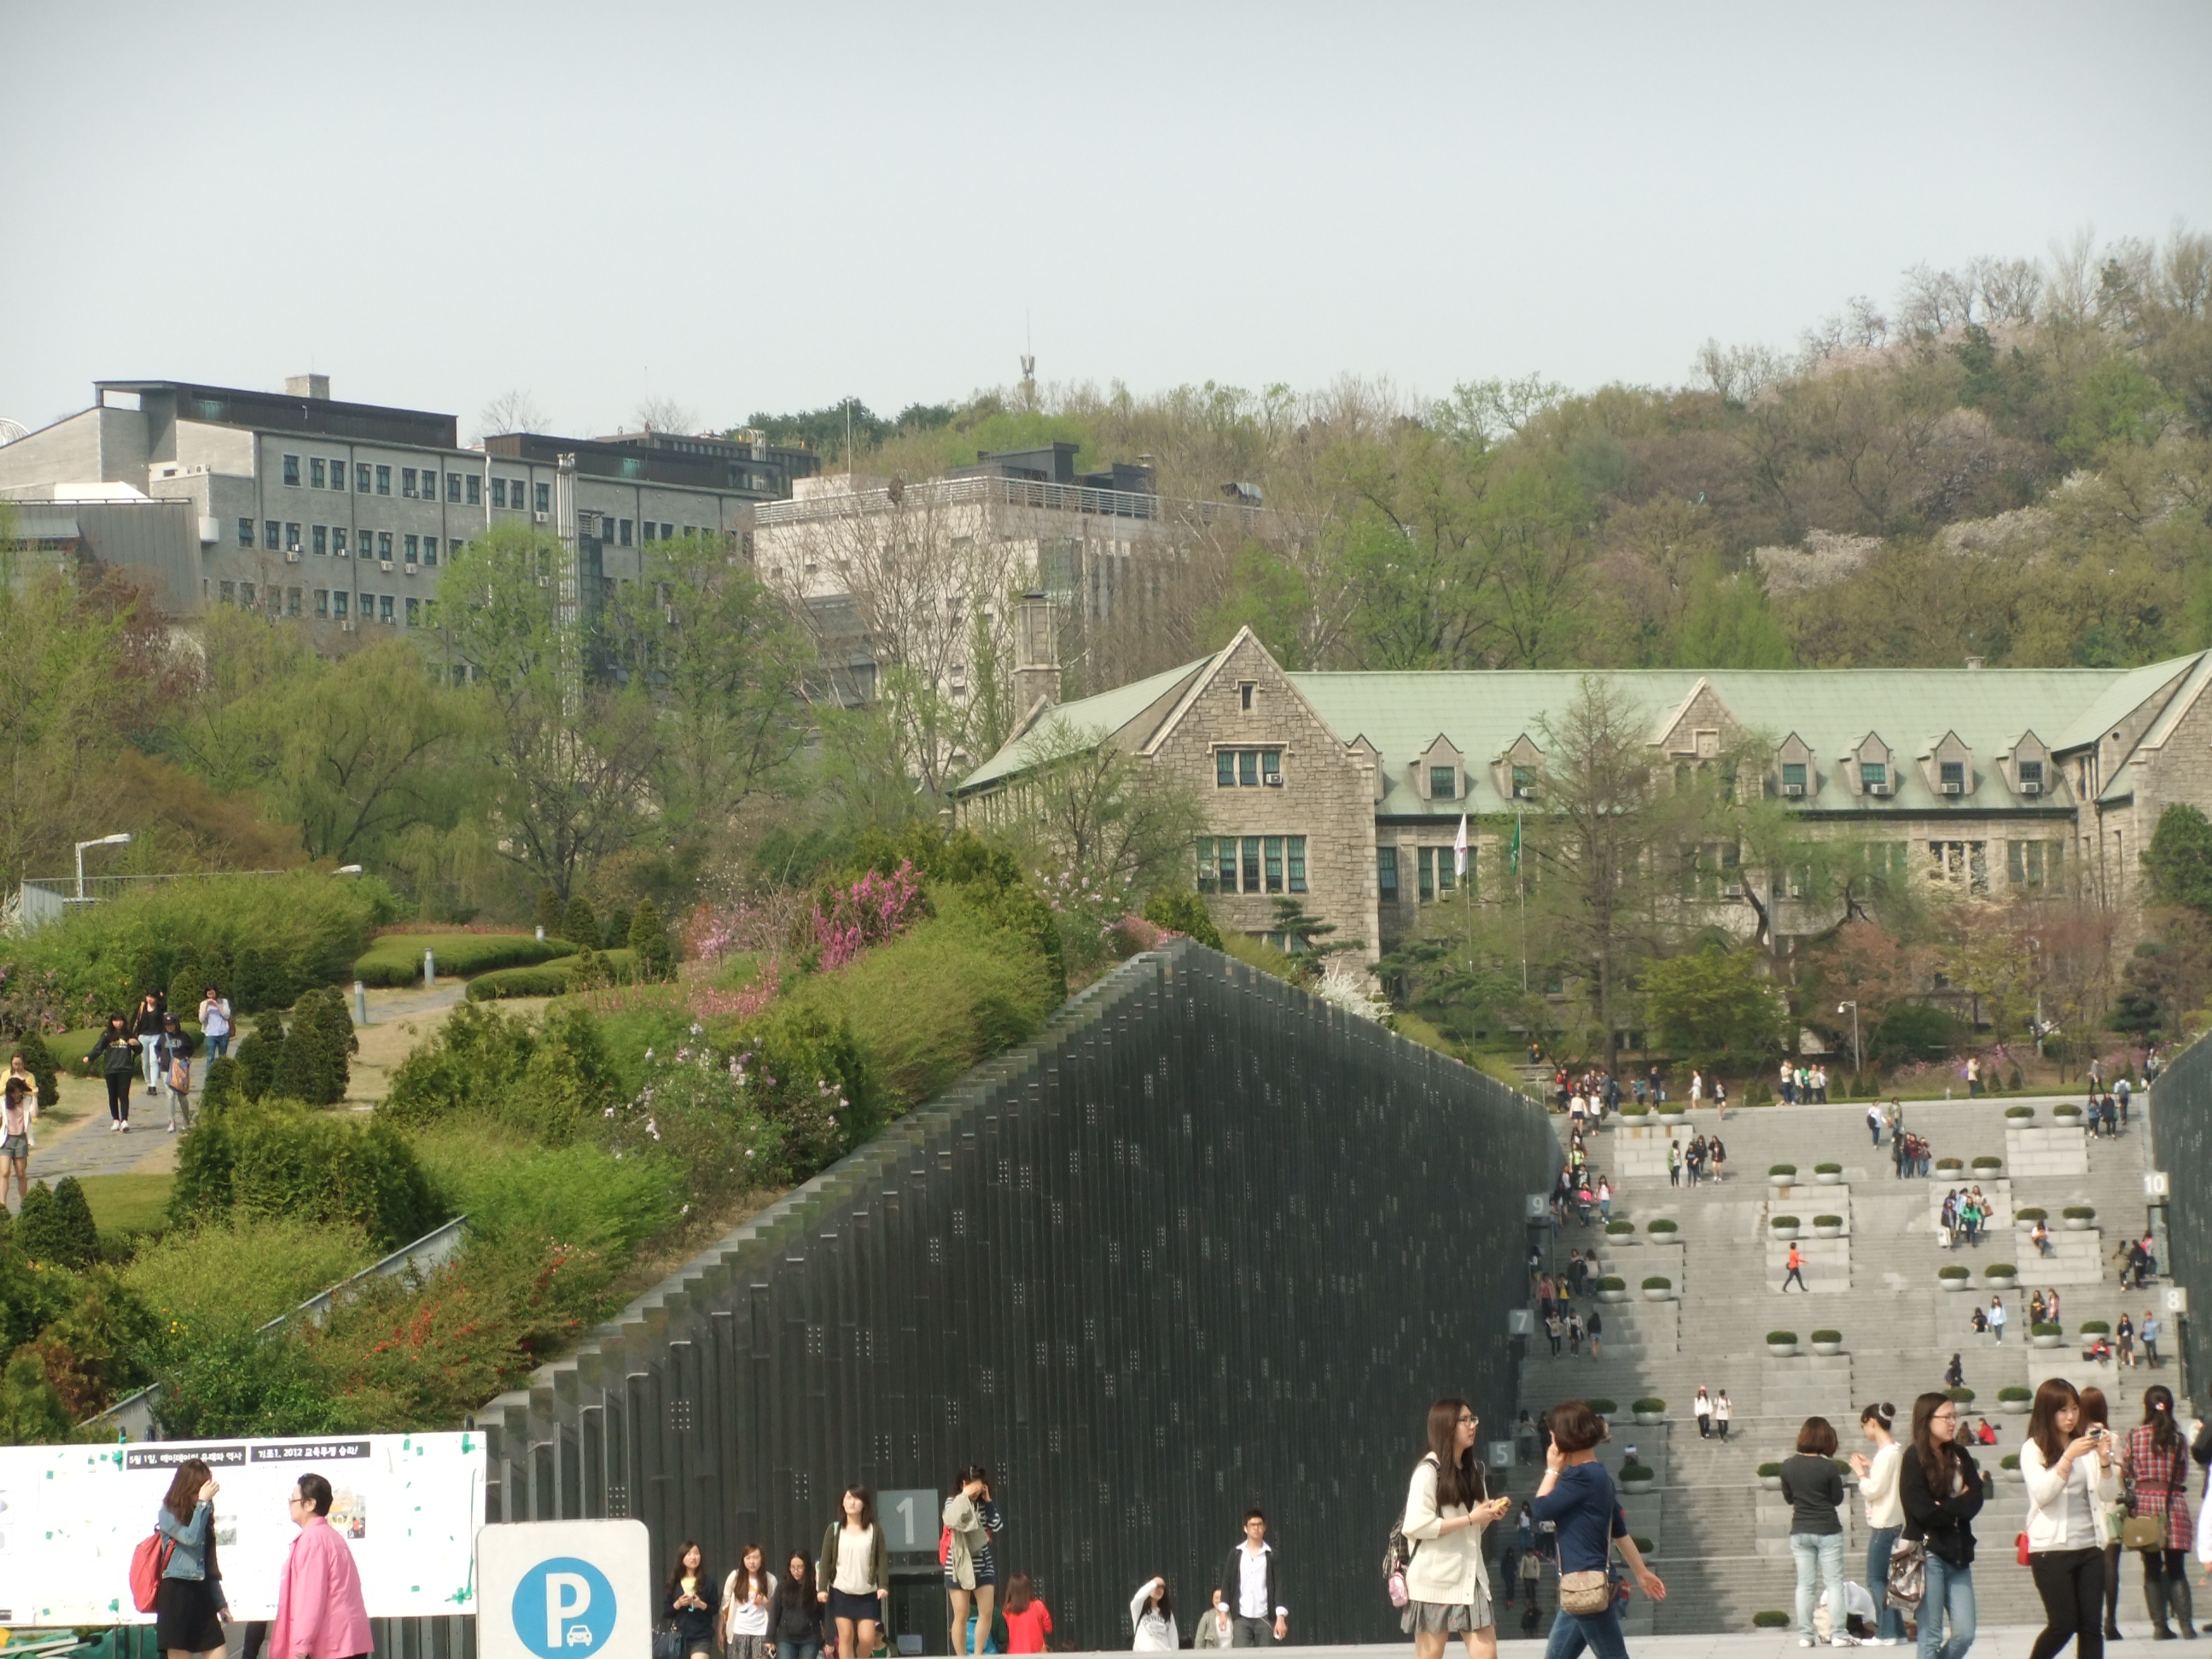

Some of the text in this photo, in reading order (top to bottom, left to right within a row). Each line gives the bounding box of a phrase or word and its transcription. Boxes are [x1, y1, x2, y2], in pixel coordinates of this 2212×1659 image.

[2144, 1174, 2164, 1193] 10
[1532, 1196, 1544, 1214] 9
[2167, 1290, 2180, 1310] 8
[1516, 1313, 1528, 1331] 7
[282, 1447, 303, 1458] 2012
[1497, 1444, 1508, 1464] 5
[896, 1497, 914, 1545] 1
[545, 1572, 591, 1648] P
